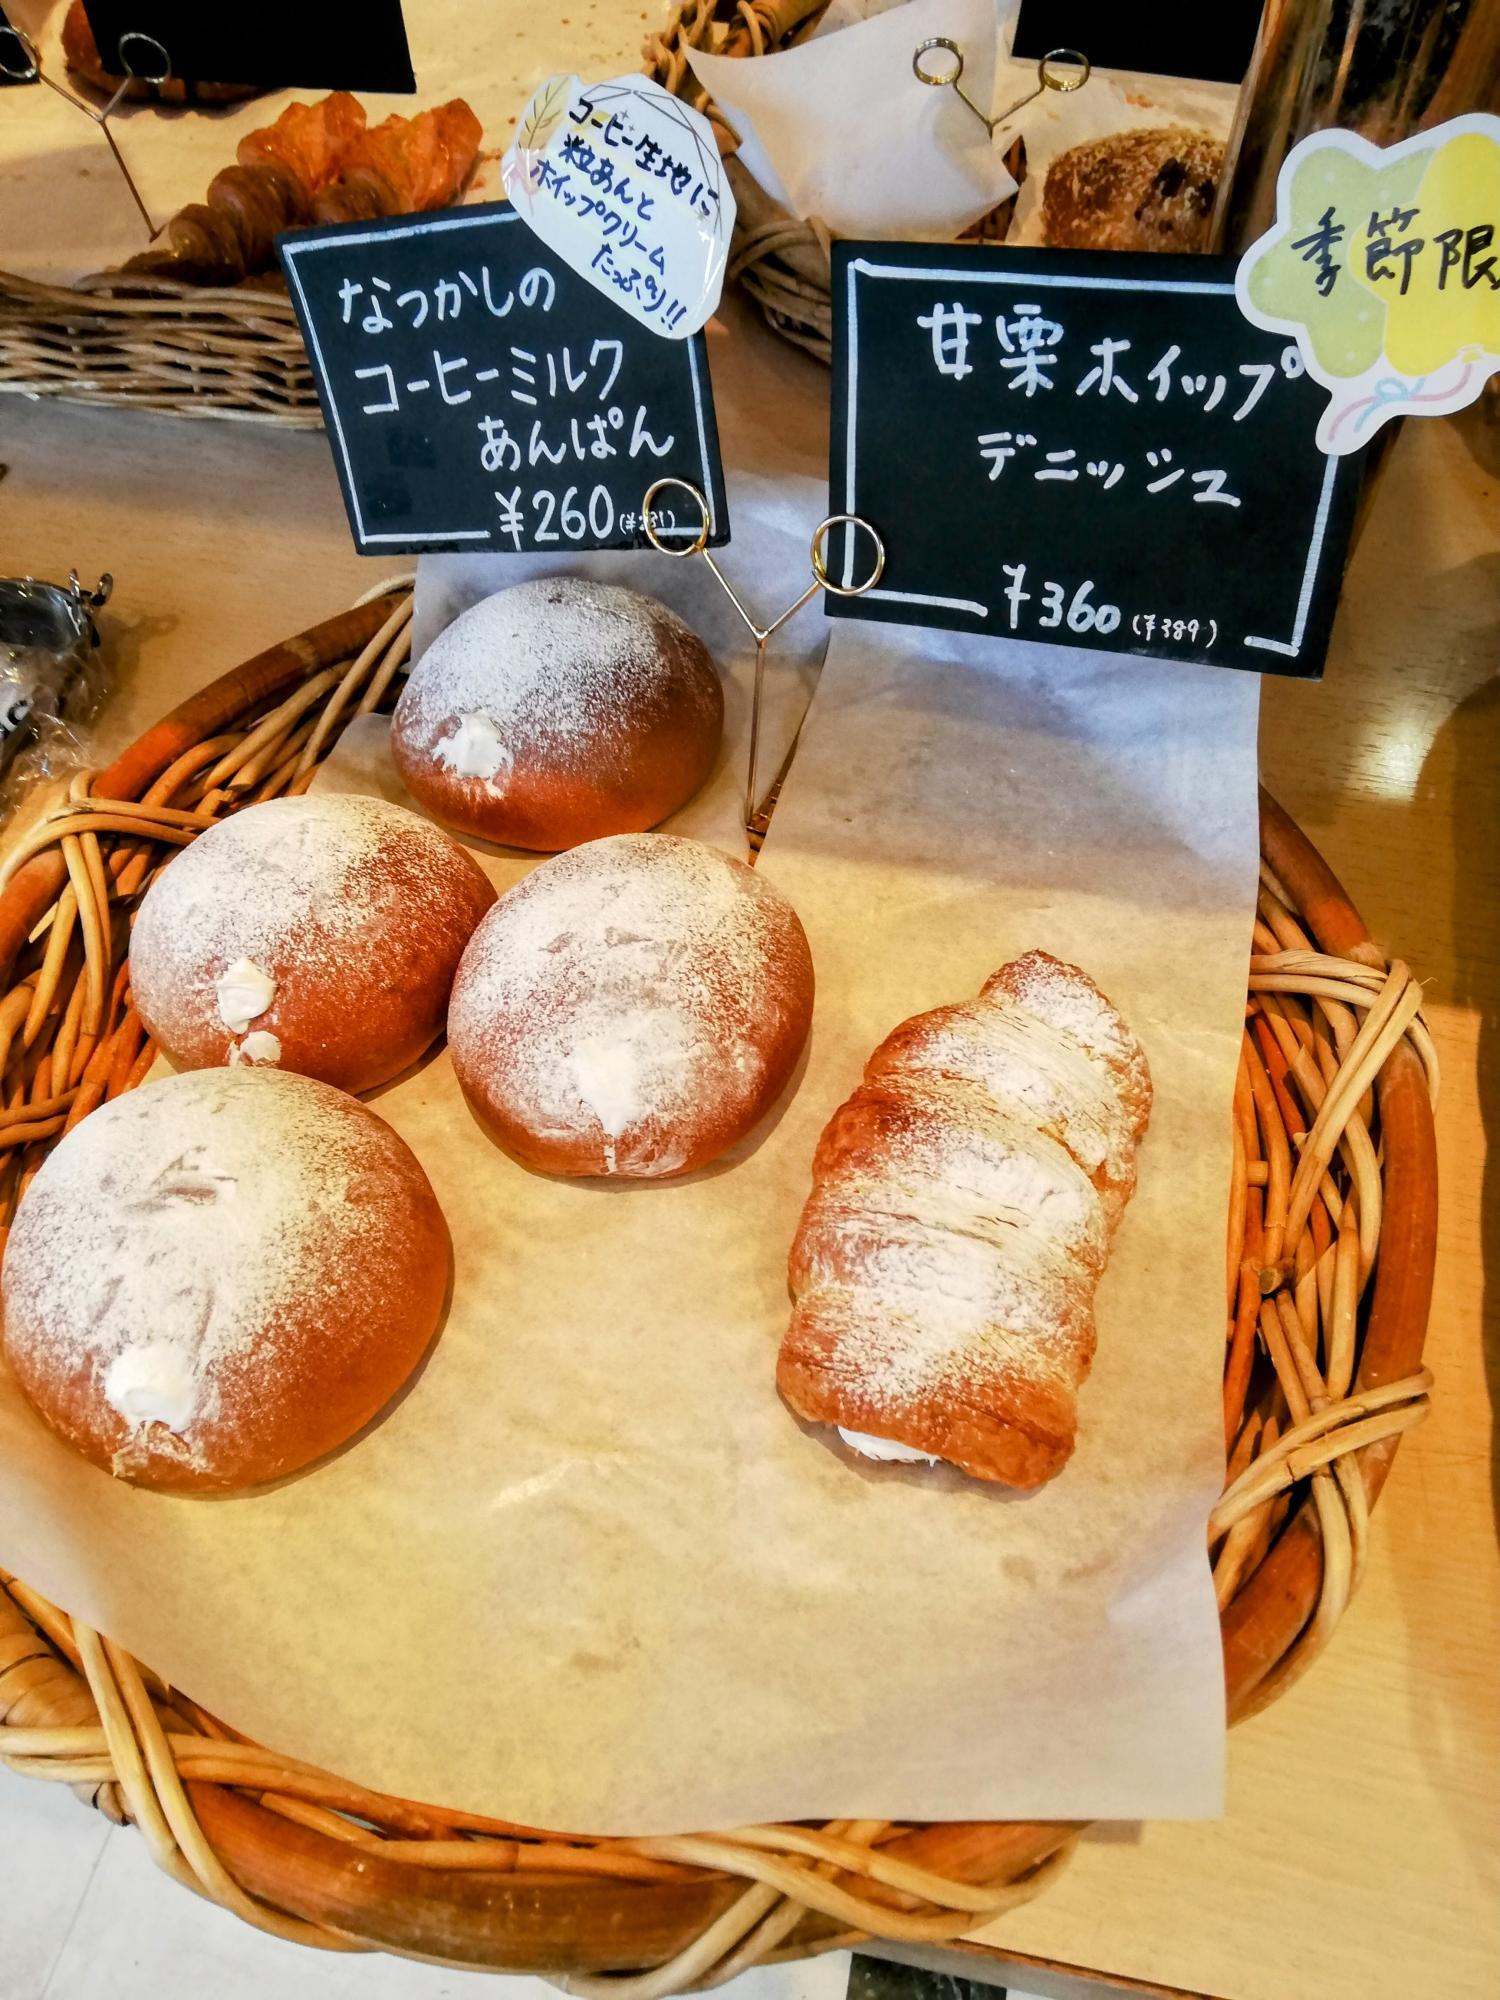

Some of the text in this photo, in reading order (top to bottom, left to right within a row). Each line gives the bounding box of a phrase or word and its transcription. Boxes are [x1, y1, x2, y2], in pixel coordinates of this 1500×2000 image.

[558, 133, 655, 221] 粒あんと
[569, 98, 719, 216] コーヒー生地に
[530, 159, 666, 275] ホイップクリーム
[1290, 206, 1500, 297] 季節限
[338, 265, 556, 334] なつかしの
[354, 338, 624, 415] コーヒーミルク
[916, 302, 1304, 422] 甘栗ホイップ
[477, 405, 675, 472] あんぱん
[977, 430, 1242, 507] デニッシュ
